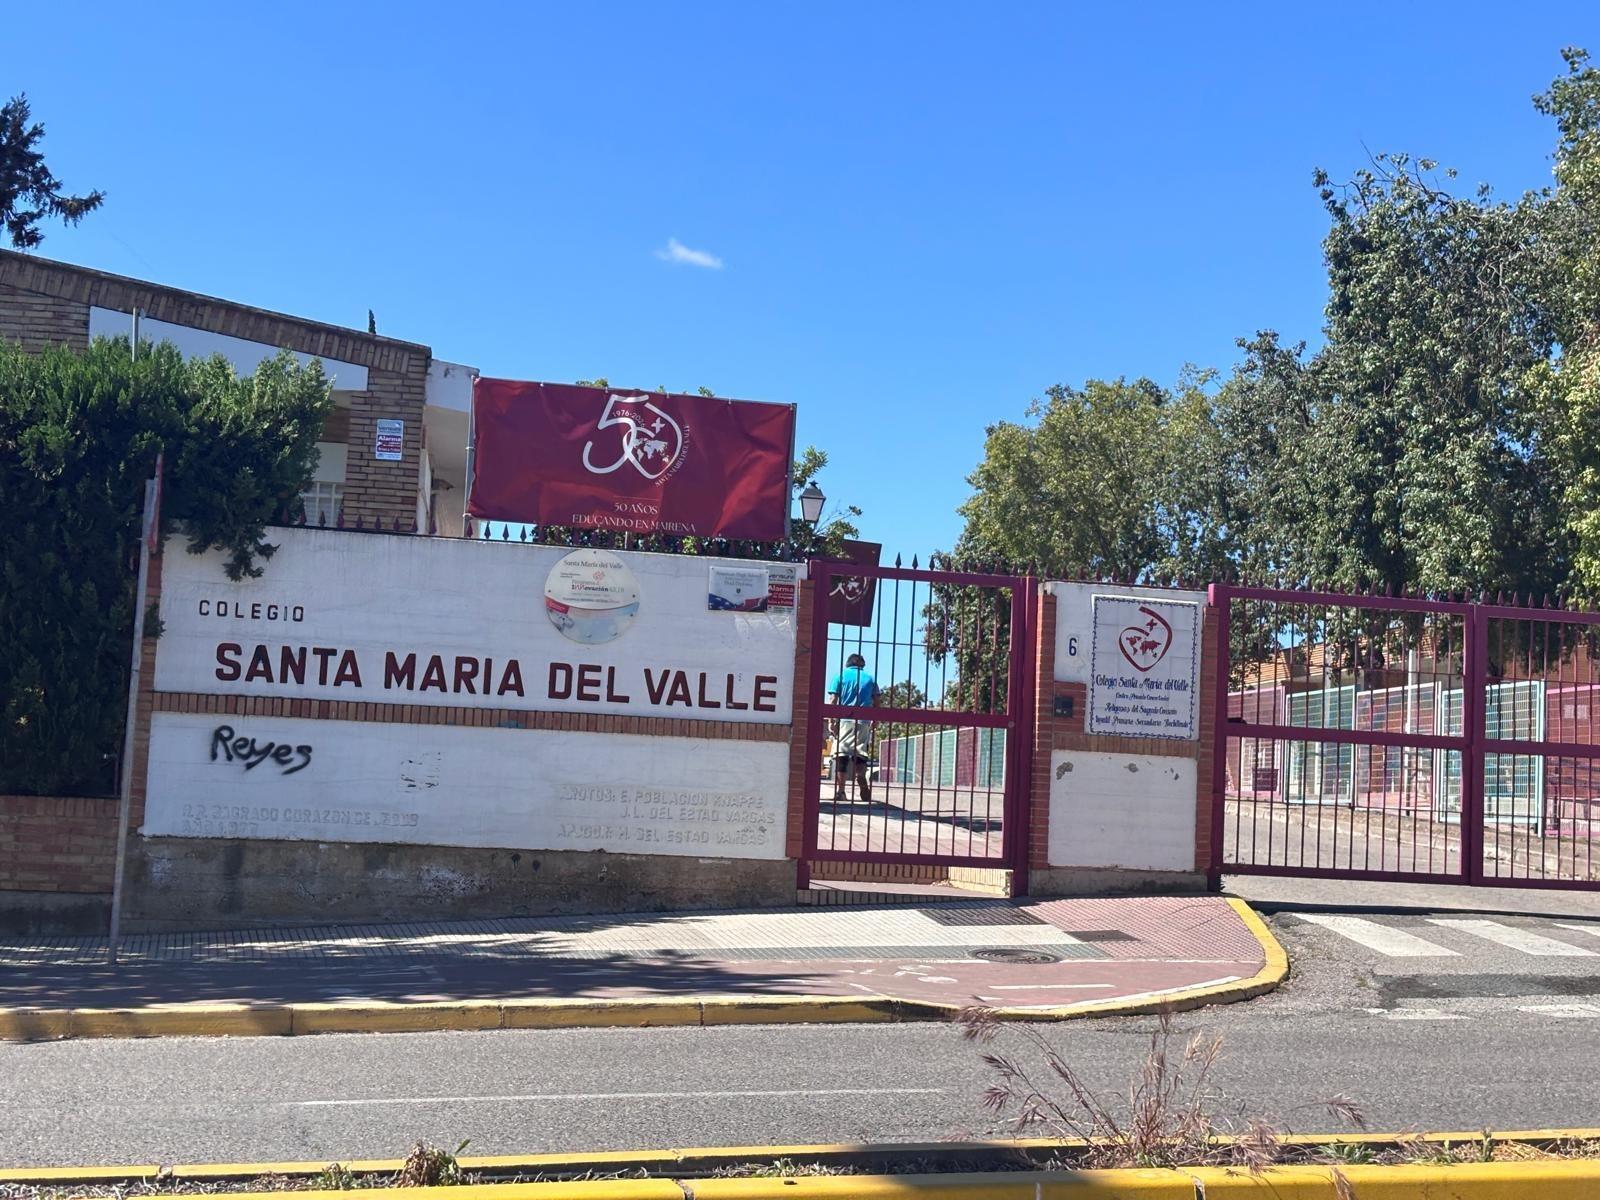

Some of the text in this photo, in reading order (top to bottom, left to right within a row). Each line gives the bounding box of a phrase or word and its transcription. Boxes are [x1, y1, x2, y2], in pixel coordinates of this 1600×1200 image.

[614, 502, 658, 514] 50 AÑOS
[572, 514, 697, 533] EDUCANDO EN MAIRENA
[768, 584, 794, 592] Alarma
[199, 600, 304, 622] COLEGIO
[1068, 637, 1078, 657] 6
[215, 642, 778, 712] SANTA MARIA DEL VALLE
[1095, 673, 1118, 690] Colegio
[1118, 676, 1138, 689] Santa
[1164, 678, 1174, 690] del
[210, 725, 313, 776] Reyes
